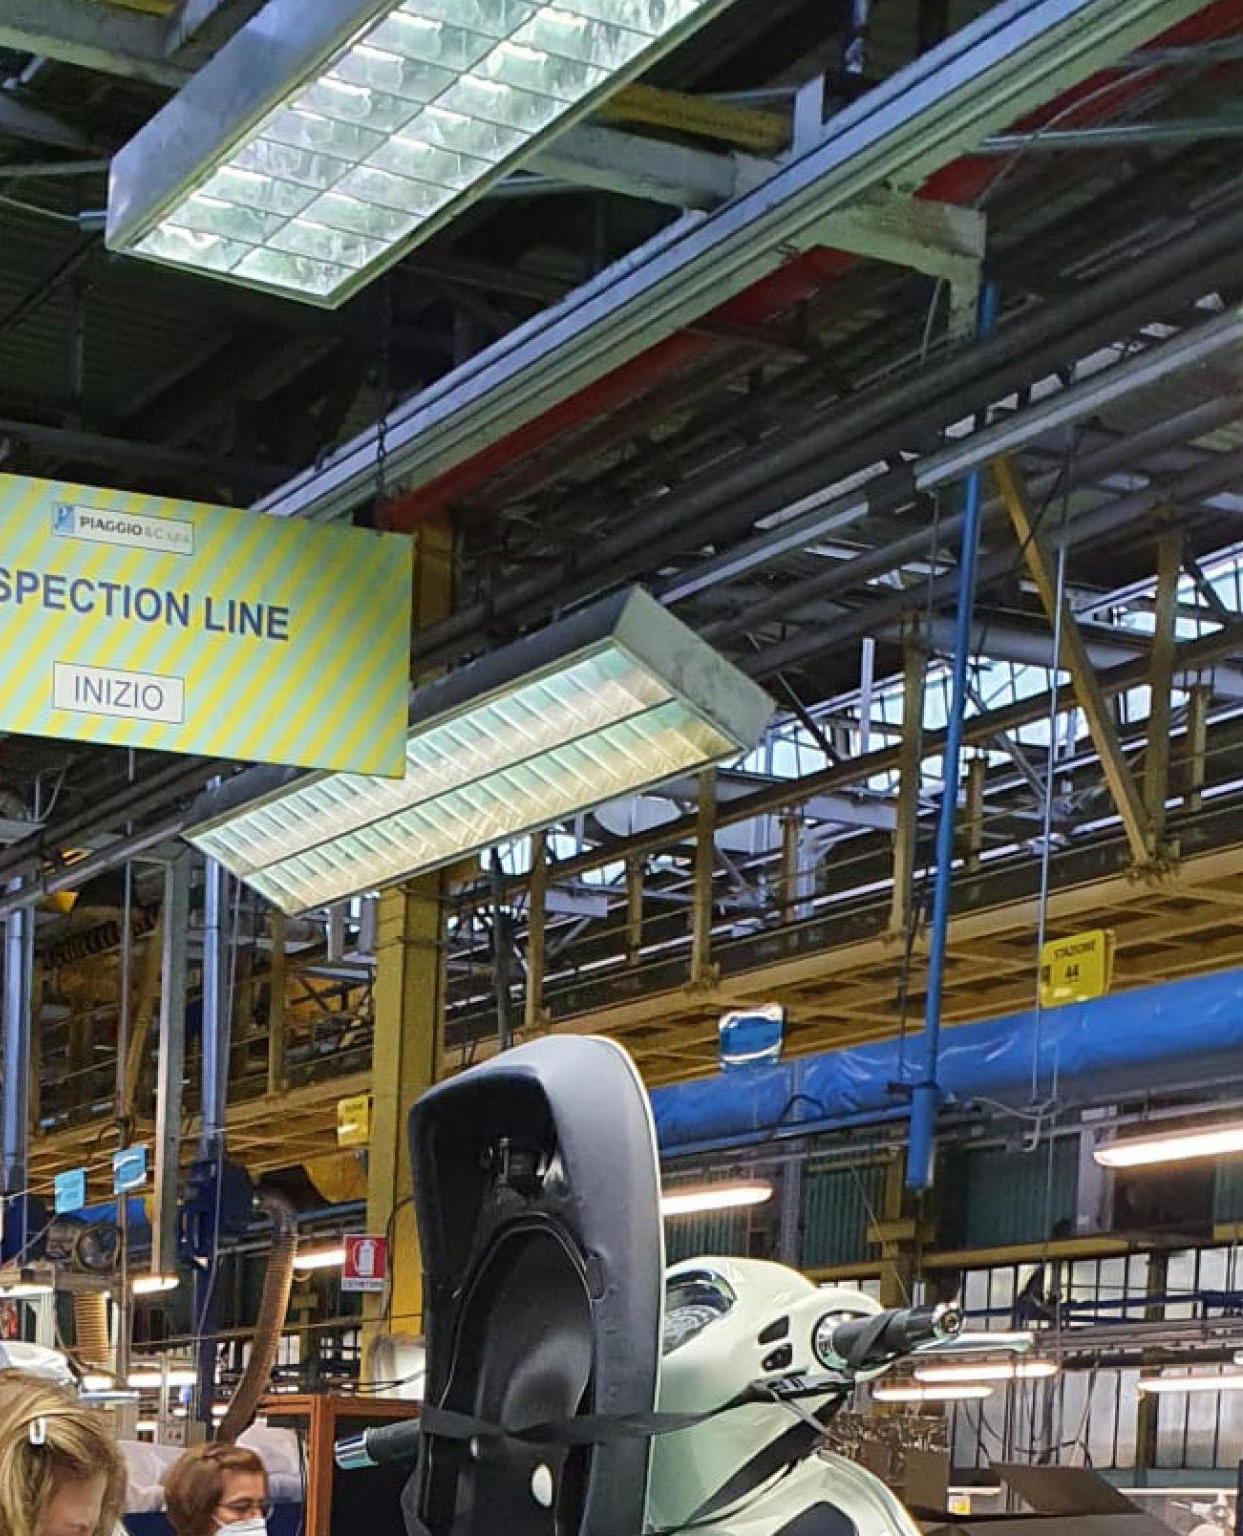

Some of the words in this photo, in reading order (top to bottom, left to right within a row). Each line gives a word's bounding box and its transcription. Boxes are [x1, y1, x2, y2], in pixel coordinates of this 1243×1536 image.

[79, 515, 143, 536] PIAGGIO
[203, 596, 291, 642] LINE
[73, 674, 166, 713] INIZIO
